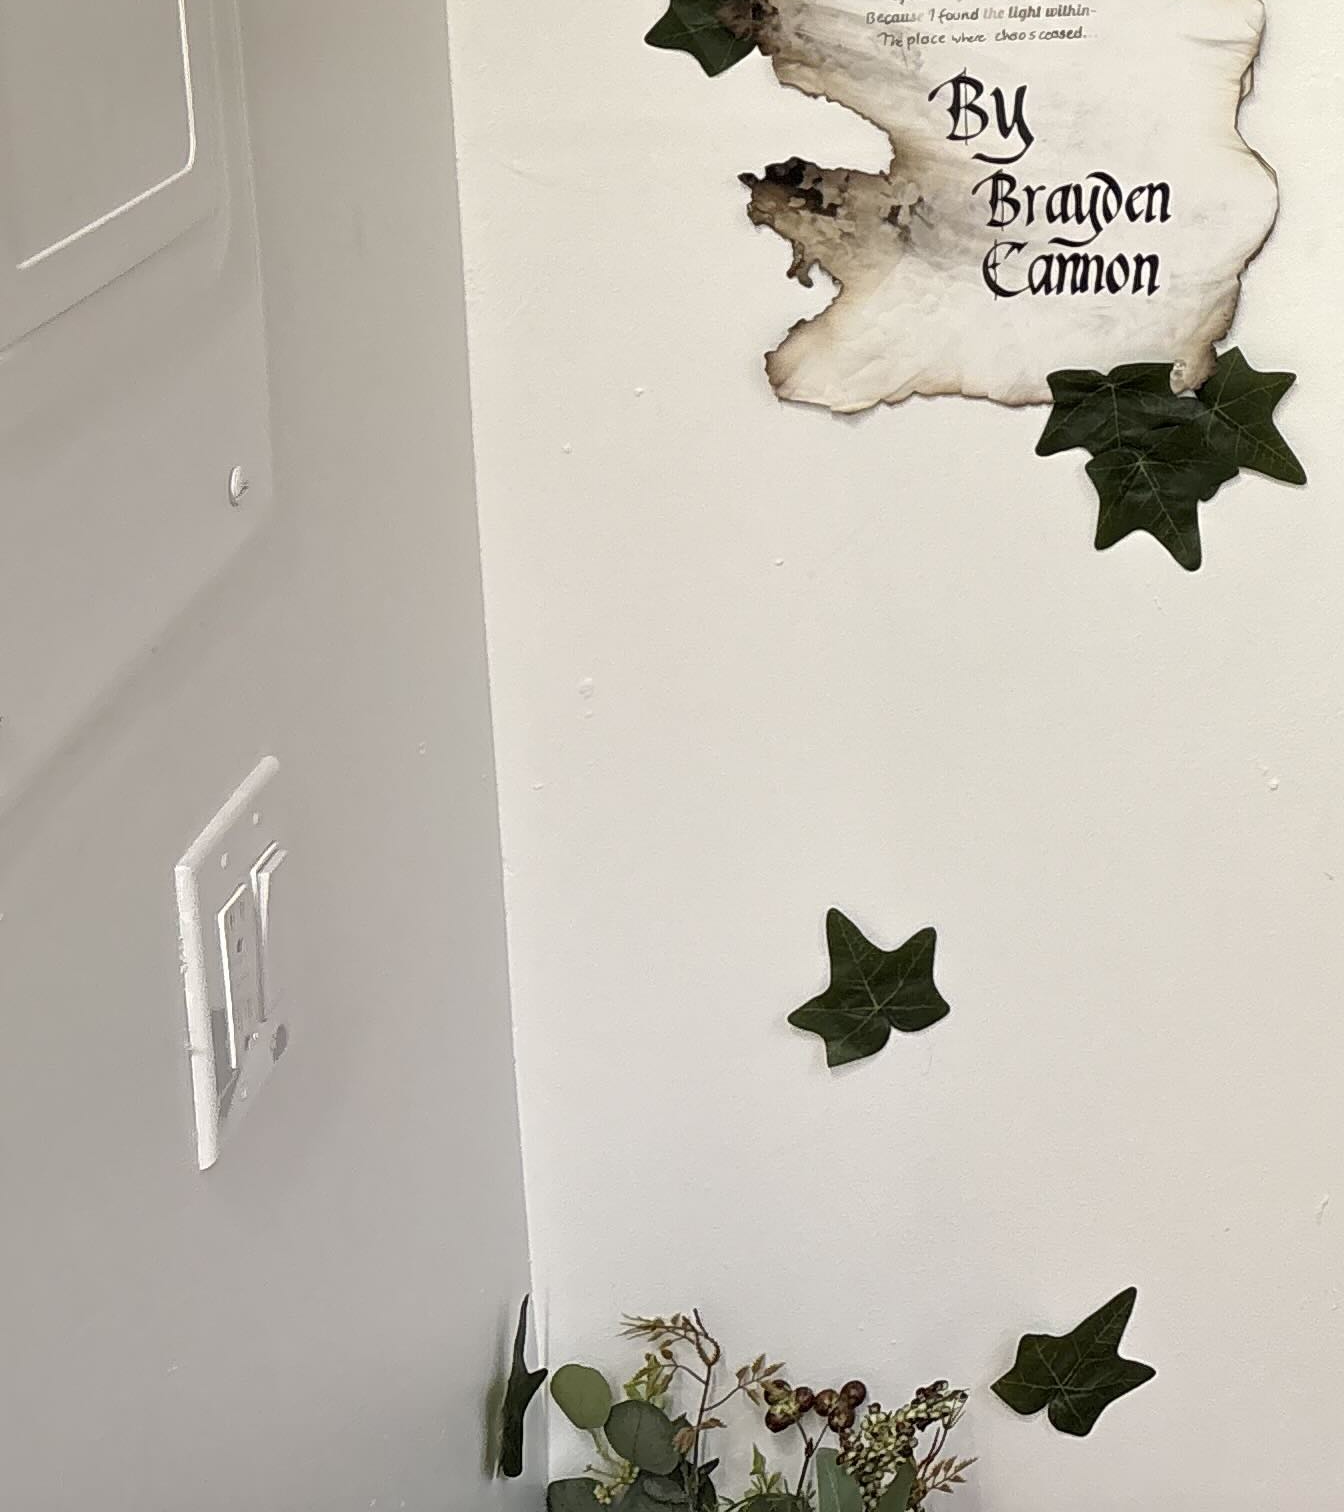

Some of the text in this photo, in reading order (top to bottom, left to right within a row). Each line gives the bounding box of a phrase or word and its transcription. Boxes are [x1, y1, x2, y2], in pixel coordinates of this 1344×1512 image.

[938, 6, 1041, 24] found light
[928, 67, 1034, 165] By
[972, 168, 1171, 247] Brayden
[981, 239, 1161, 300] Cannon
